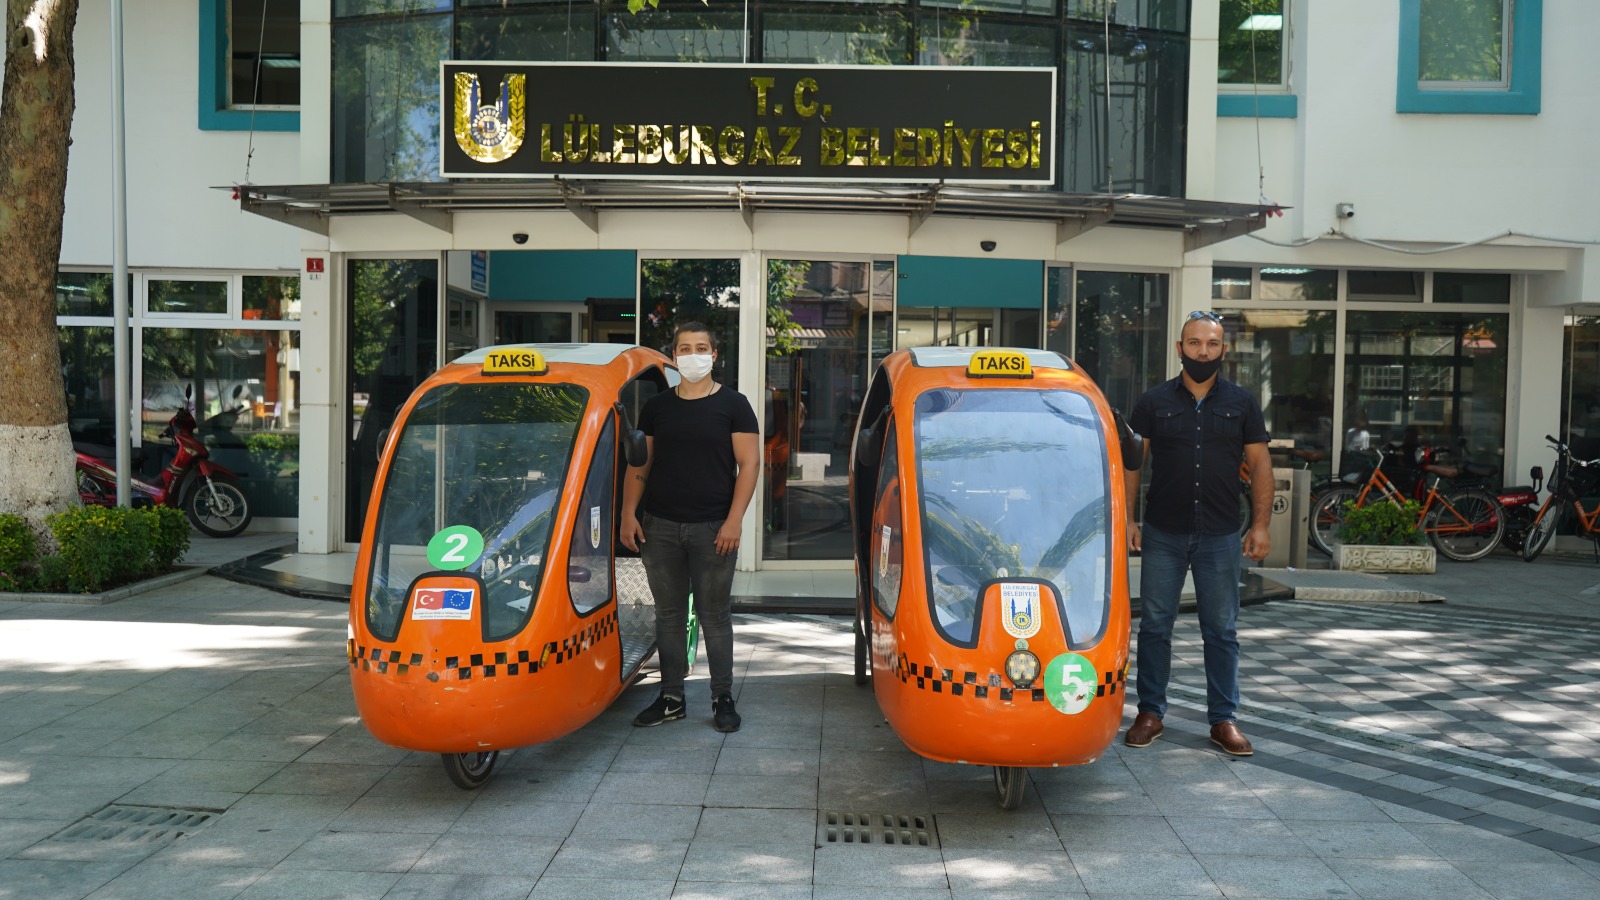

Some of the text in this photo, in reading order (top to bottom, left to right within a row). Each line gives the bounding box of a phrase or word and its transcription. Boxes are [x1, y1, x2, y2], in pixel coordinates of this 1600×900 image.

[540, 114, 1041, 168] LÜLEBURGAZ BELEDİYESİ
[440, 533, 469, 562] 2
[1061, 664, 1086, 706] 5
